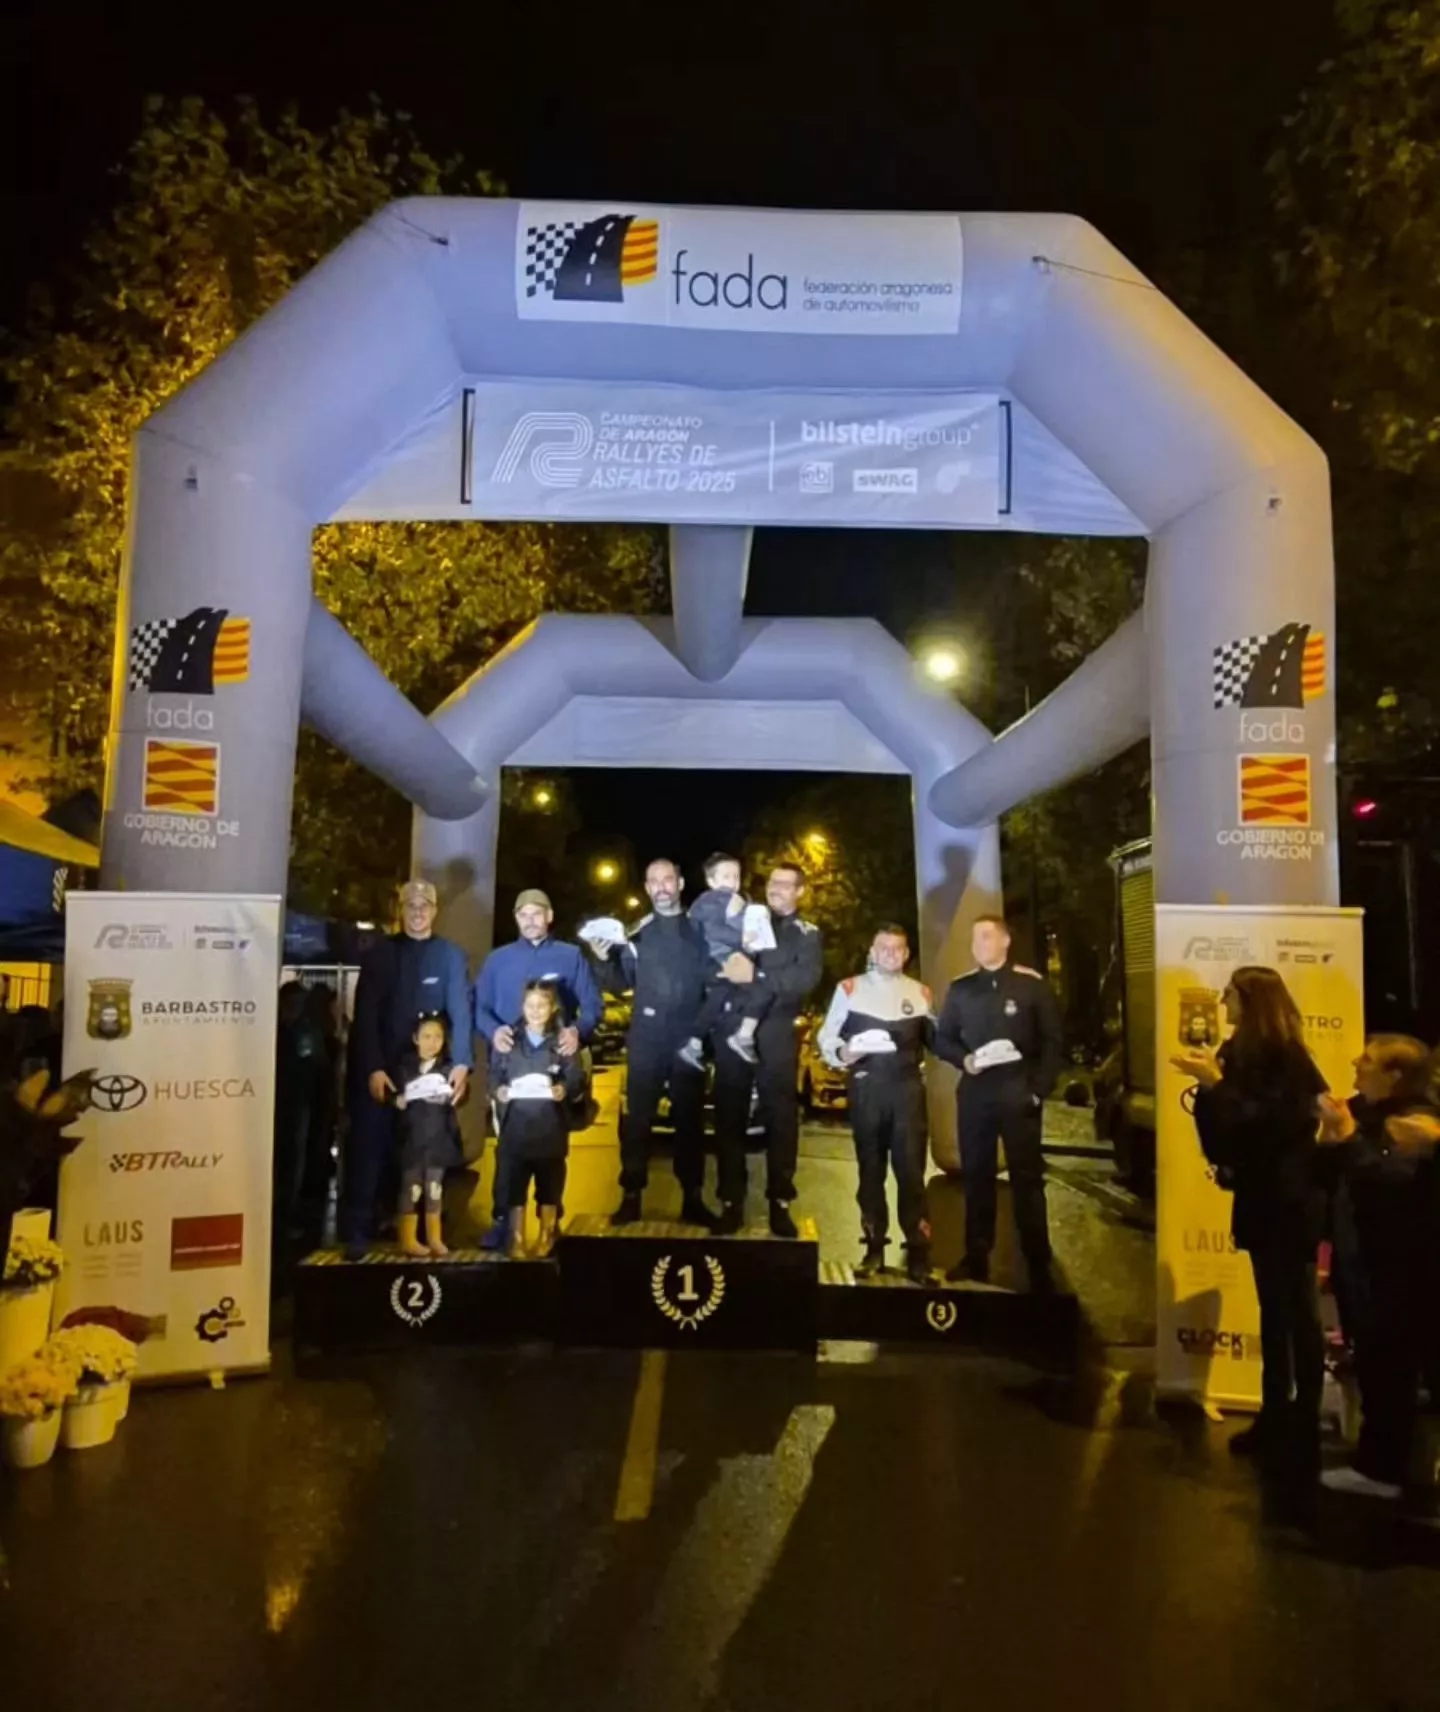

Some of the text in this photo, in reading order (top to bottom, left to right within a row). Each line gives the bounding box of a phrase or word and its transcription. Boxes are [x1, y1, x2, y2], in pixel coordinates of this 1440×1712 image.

[671, 249, 788, 311] fada
[803, 275, 953, 297] federación aragonesa
[803, 298, 920, 312] de automovilismo
[600, 412, 703, 429] CAMPEONATO
[599, 427, 620, 441] DE
[593, 441, 718, 466] RALLYES DE
[588, 467, 736, 493] ASFALTO 2025
[856, 472, 915, 489] SWAG
[147, 697, 214, 730] fada
[1239, 712, 1305, 743] fada
[123, 814, 240, 836] GOBIERNO DE
[1216, 829, 1307, 846] GOBIERNO
[142, 1000, 257, 1015] BARBASTRO
[154, 1078, 256, 1100] HUESCA
[84, 1220, 144, 1247] LAUS
[677, 1264, 699, 1301] 1
[407, 1281, 425, 1307] 2
[936, 1304, 947, 1321] 3
